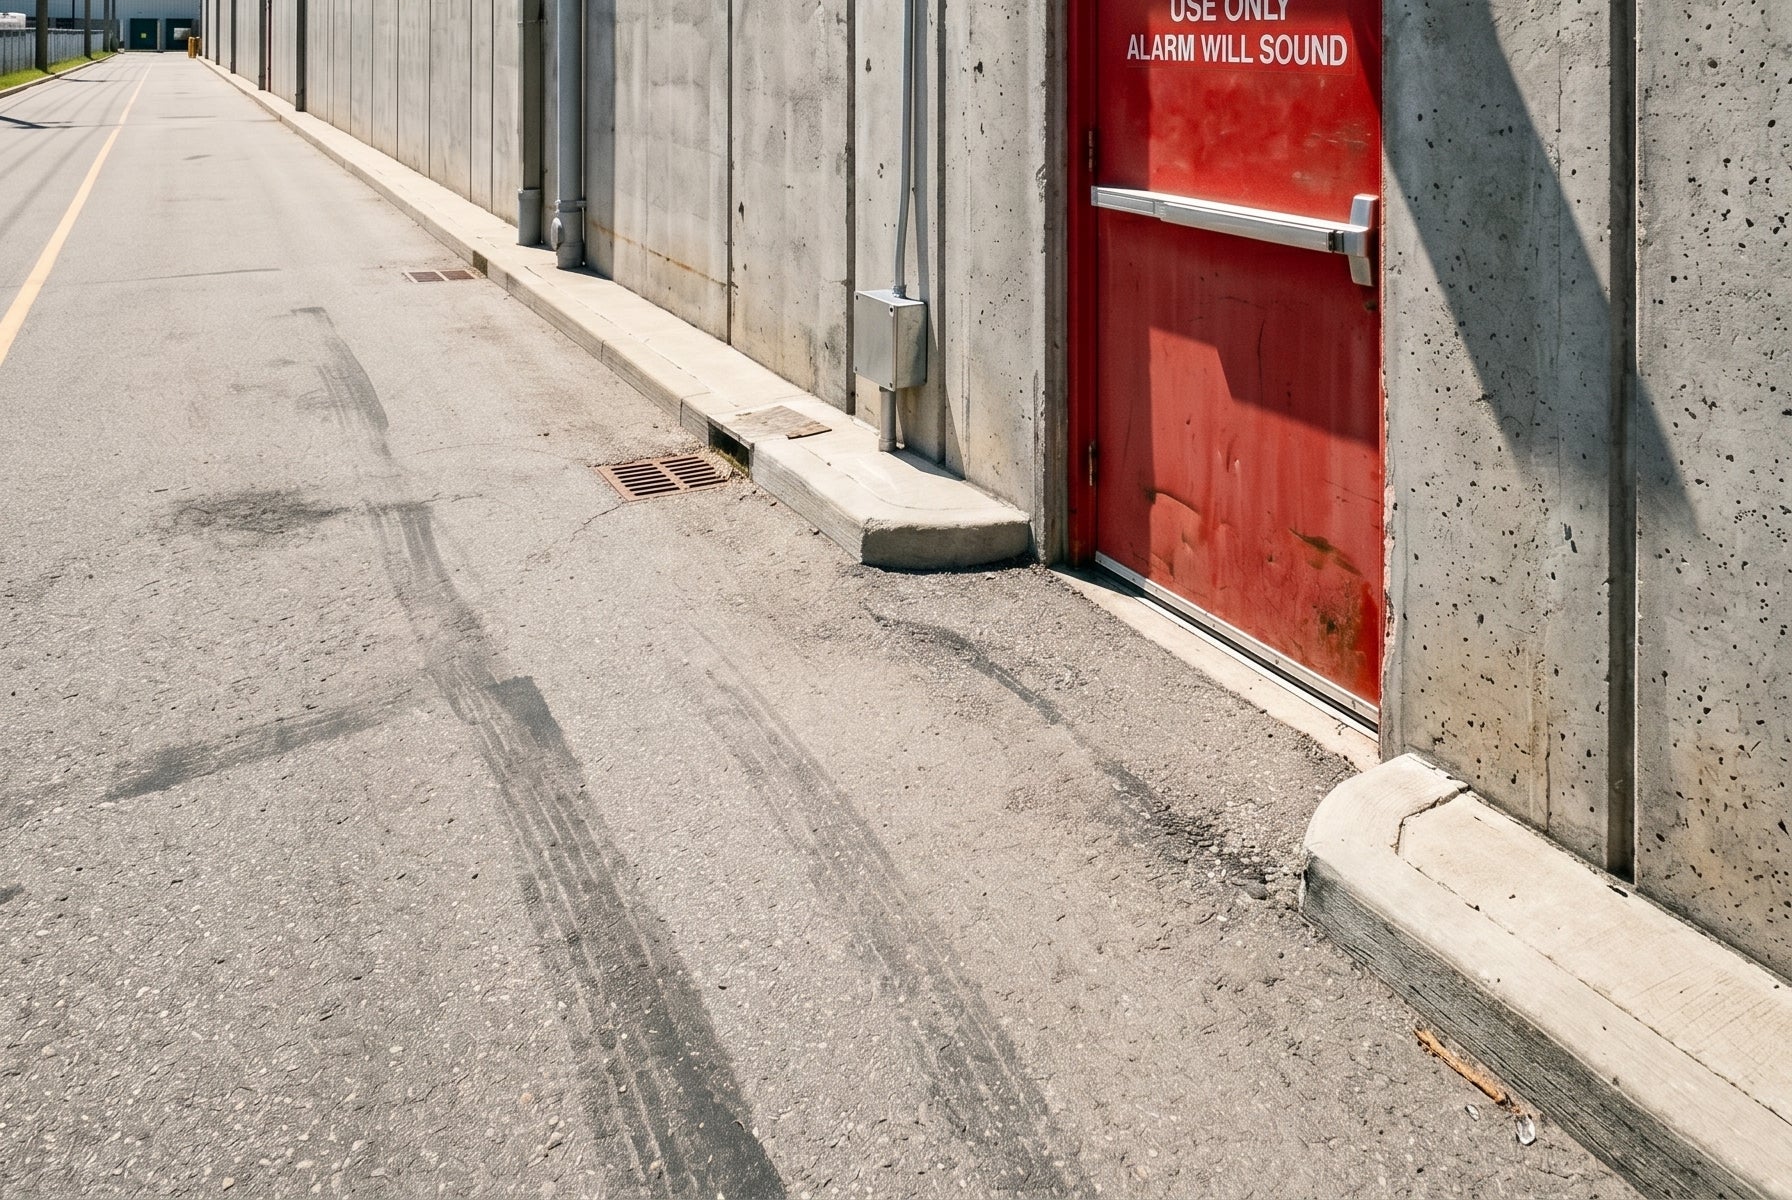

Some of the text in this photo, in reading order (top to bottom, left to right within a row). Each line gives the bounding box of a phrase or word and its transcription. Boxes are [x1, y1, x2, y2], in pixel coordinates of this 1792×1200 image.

[1126, 34, 1348, 66] ALARM WILL SOUND
